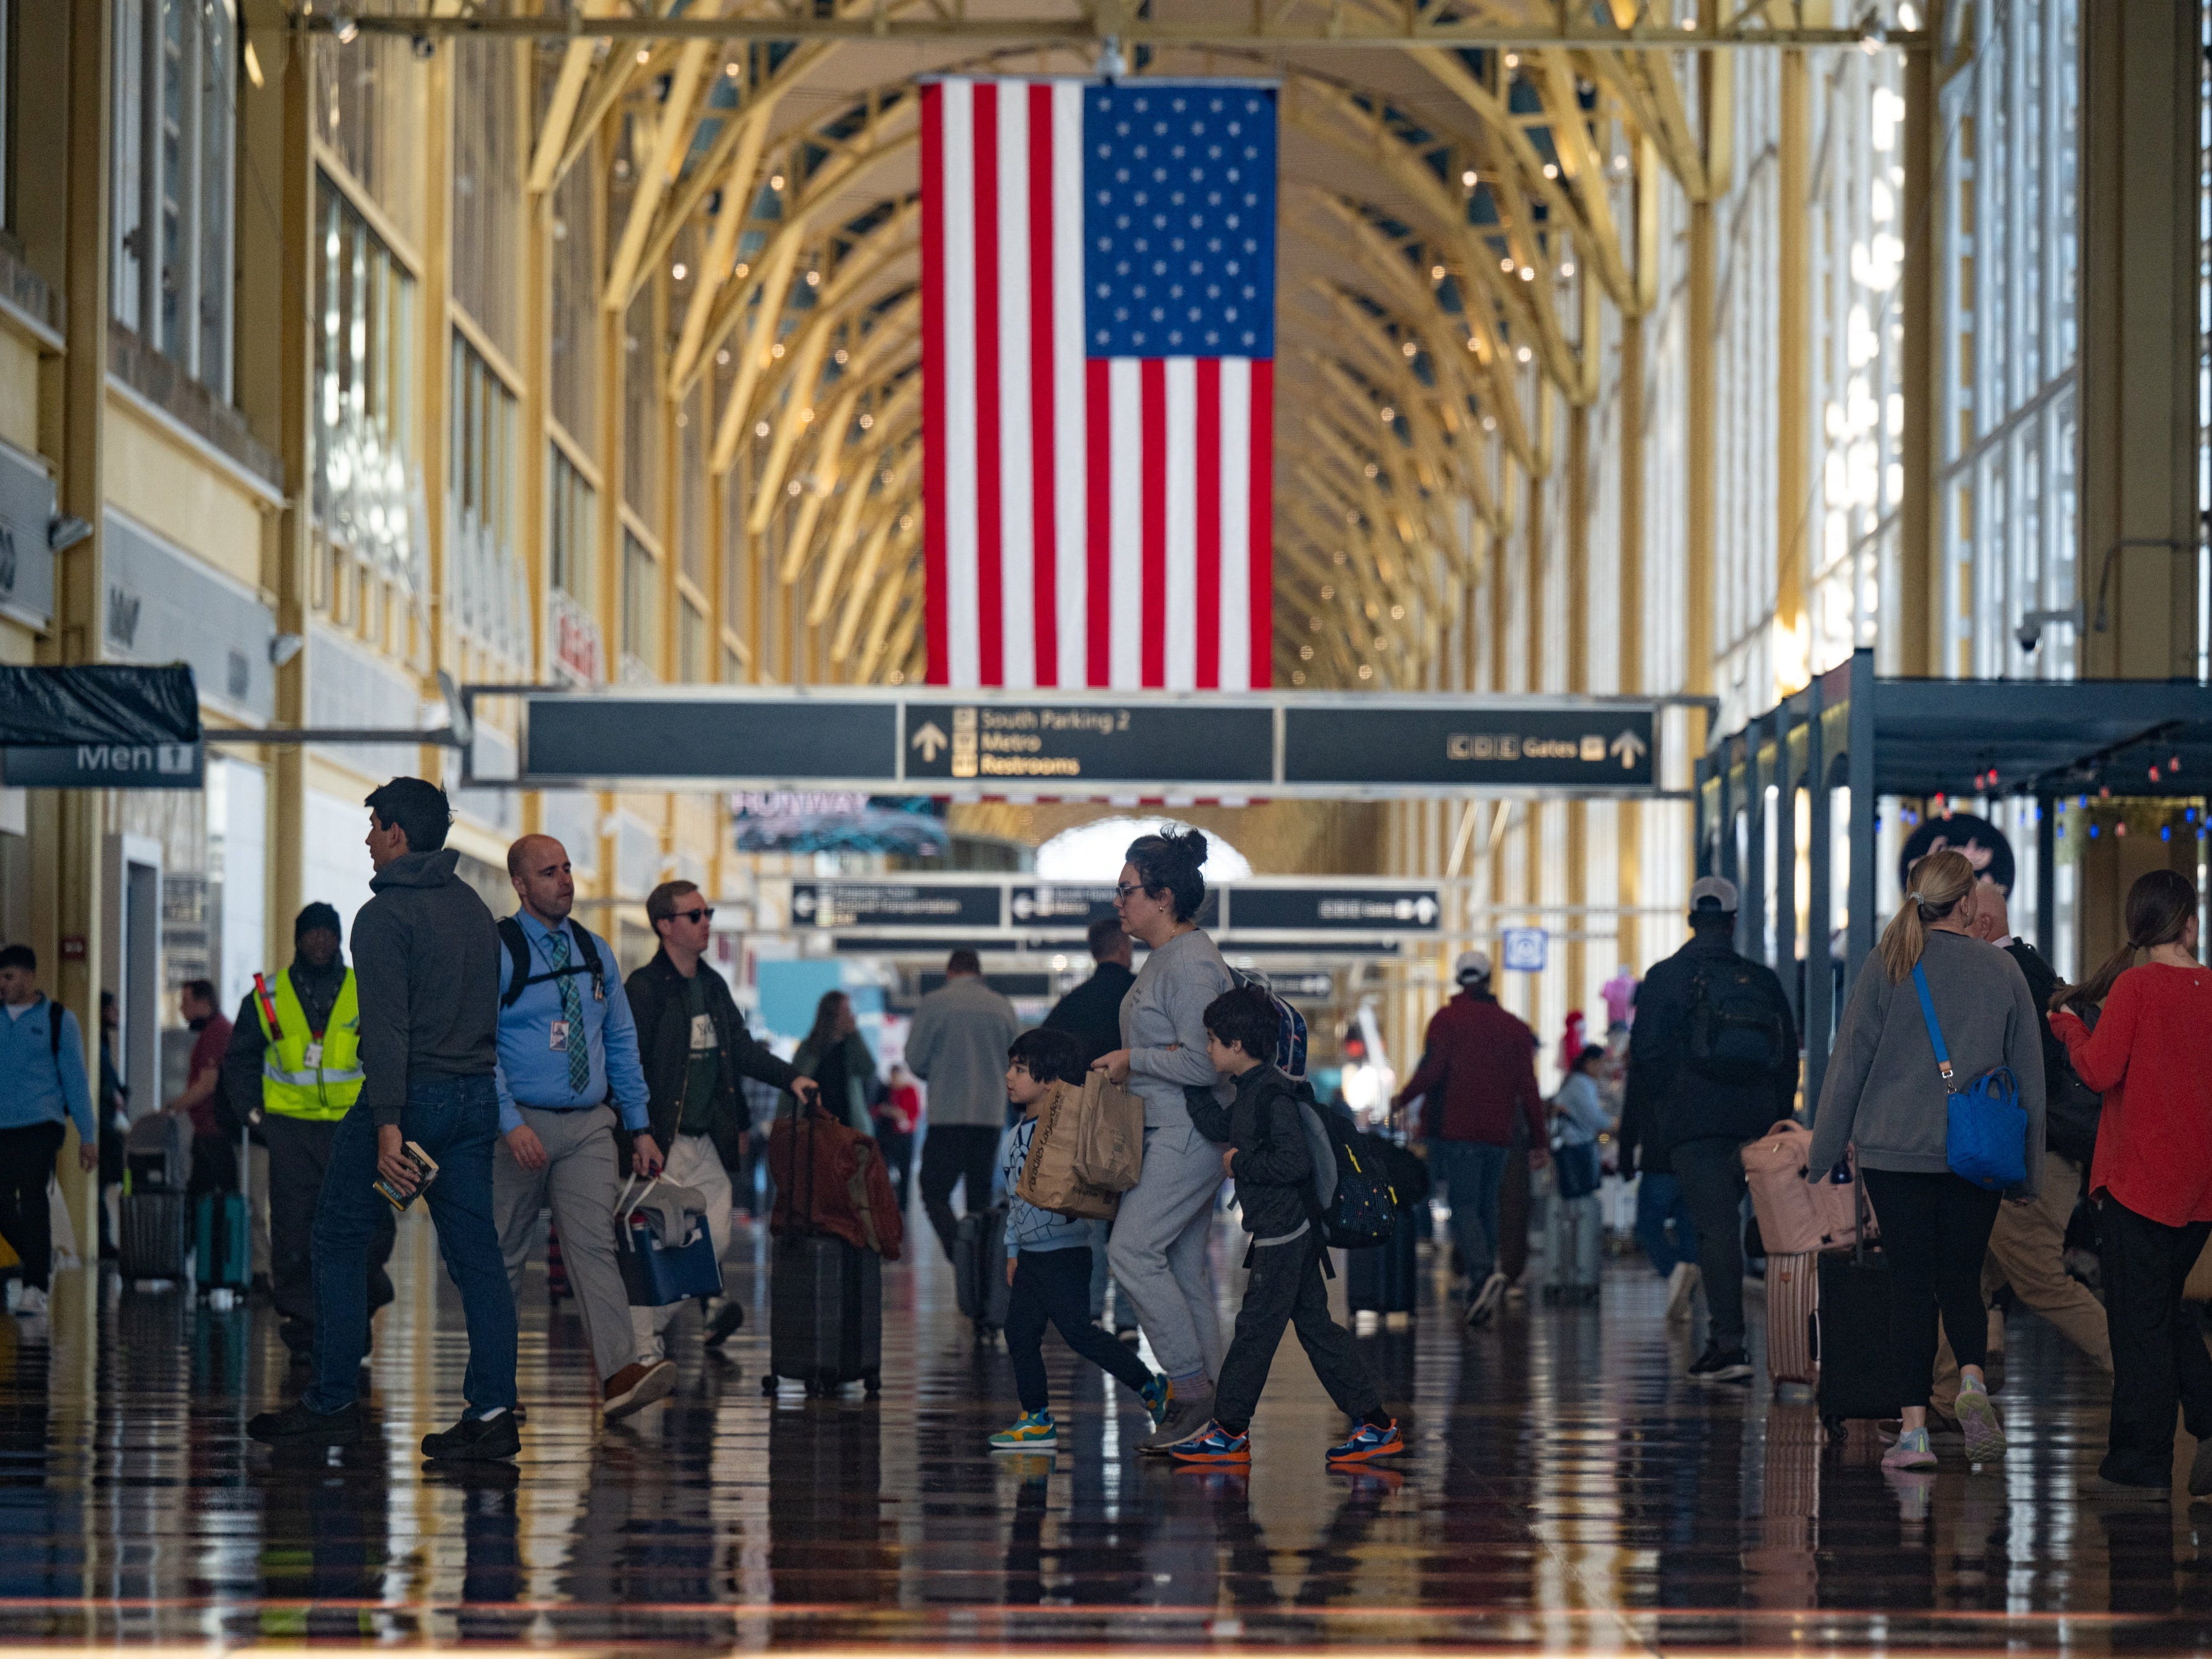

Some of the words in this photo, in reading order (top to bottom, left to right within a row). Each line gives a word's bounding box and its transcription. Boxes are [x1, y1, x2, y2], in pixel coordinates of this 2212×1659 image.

[982, 709, 1038, 729] South
[1041, 709, 1114, 735] Parking
[1118, 709, 1130, 730] 2
[981, 732, 1042, 752] Metro
[1523, 737, 1578, 758] Gates
[77, 745, 152, 771] Men
[981, 754, 1080, 775] Restrooms
